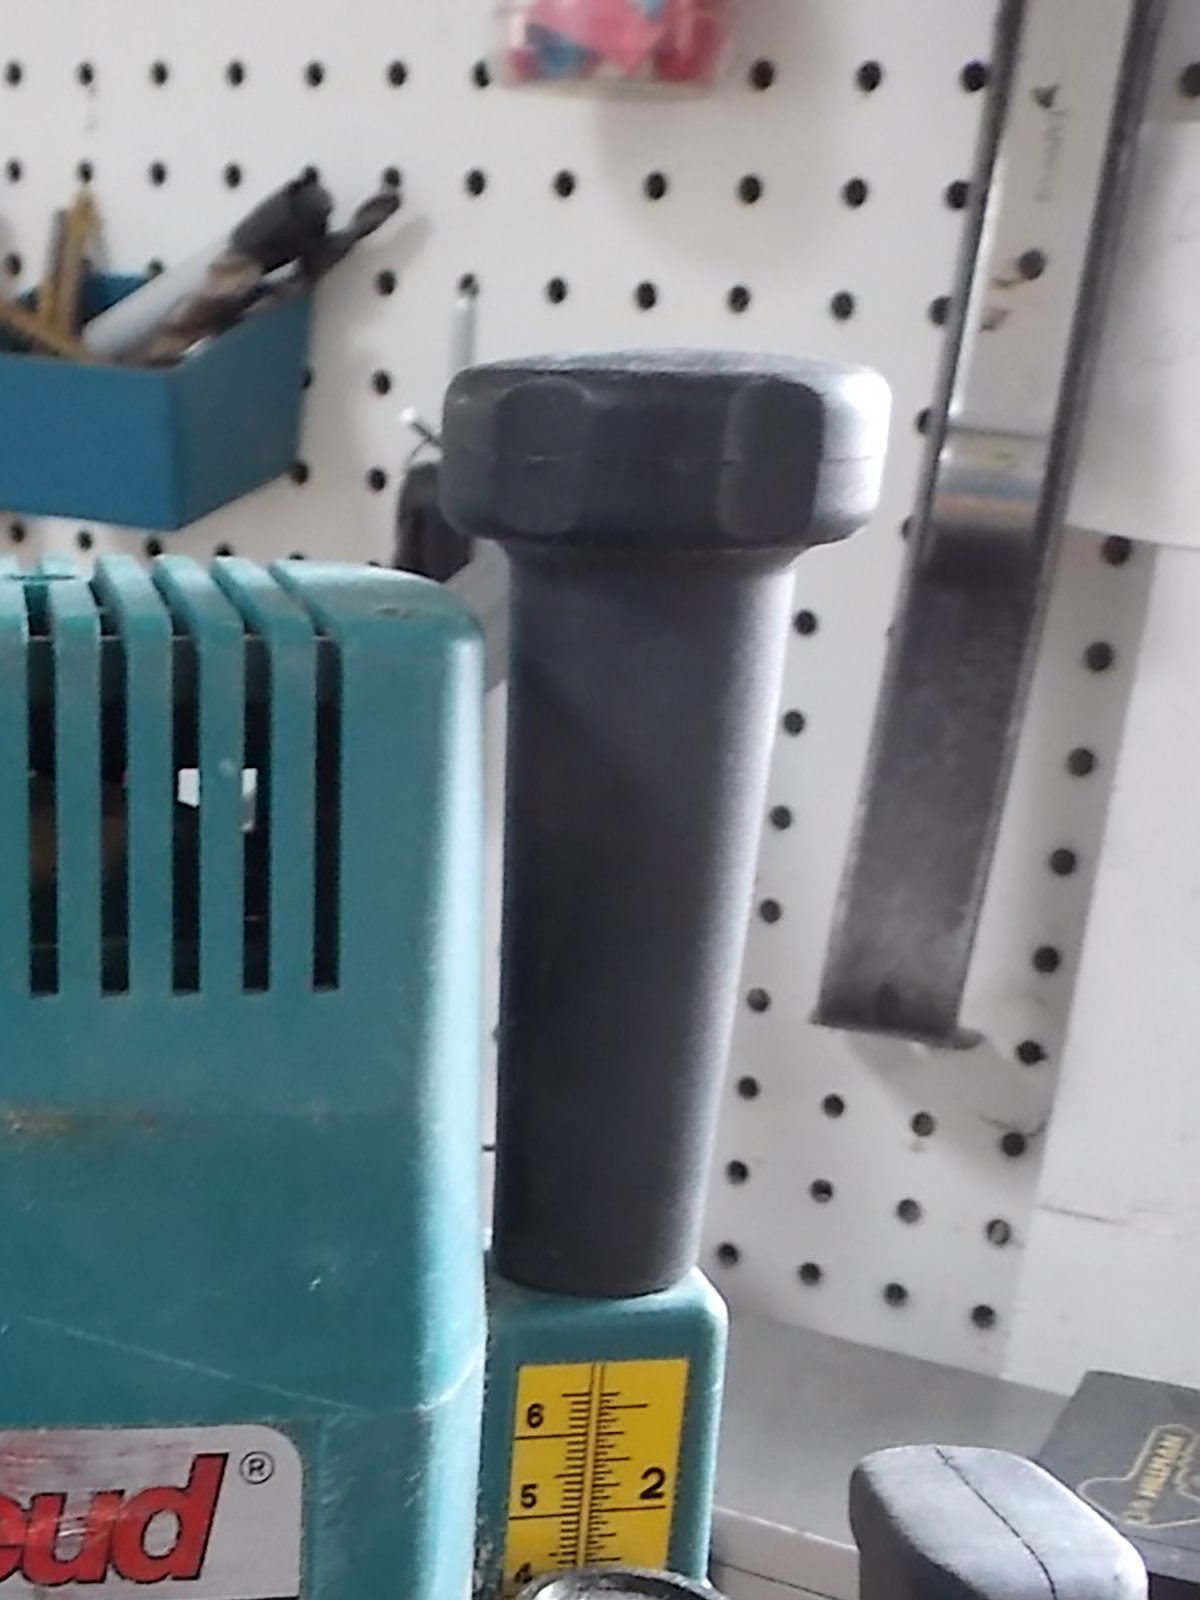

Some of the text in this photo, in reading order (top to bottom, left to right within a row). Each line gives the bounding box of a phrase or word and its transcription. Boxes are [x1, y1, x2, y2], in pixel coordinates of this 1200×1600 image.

[526, 1403, 544, 1428] 6
[520, 1483, 538, 1508] 5
[639, 1466, 666, 1500] 2
